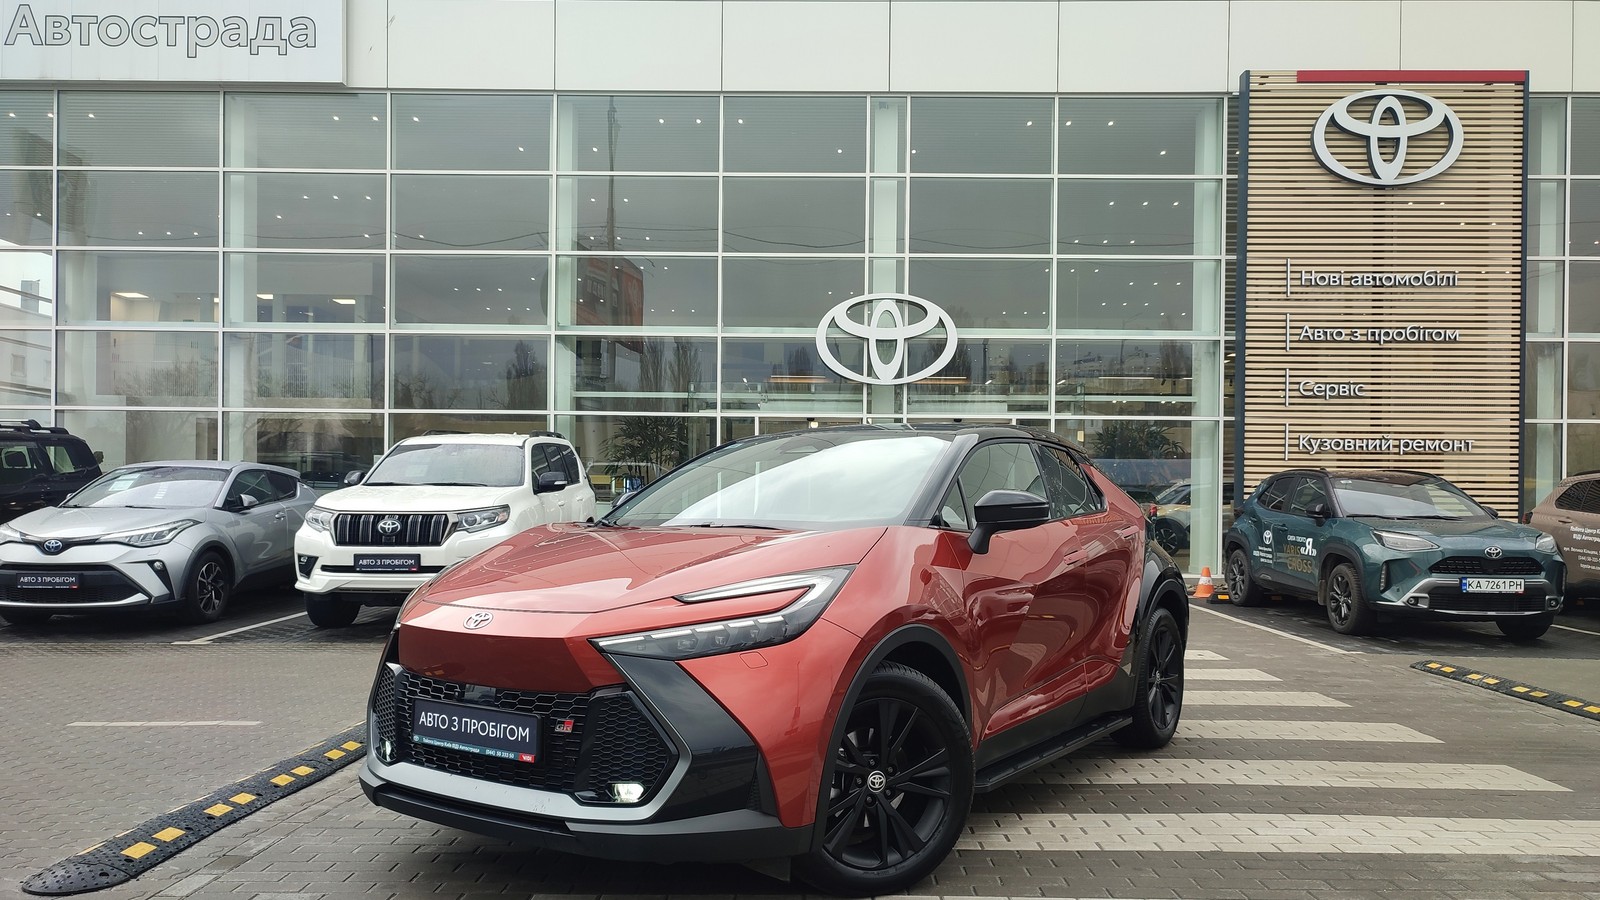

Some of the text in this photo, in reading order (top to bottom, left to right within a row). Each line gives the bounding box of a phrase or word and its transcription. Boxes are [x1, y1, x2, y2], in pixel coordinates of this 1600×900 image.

[4, 4, 317, 58] Автострада
[1301, 270, 1459, 286] Нові автомобілі
[1300, 325, 1460, 345] Авто з пробігом
[1299, 380, 1366, 400] Сервіс
[1299, 434, 1475, 455] Кузовний ремонт
[1287, 557, 1312, 573] CROSS
[1485, 580, 1506, 589] 7261
[419, 711, 530, 743] АВТО З ПРОБІГОМ
